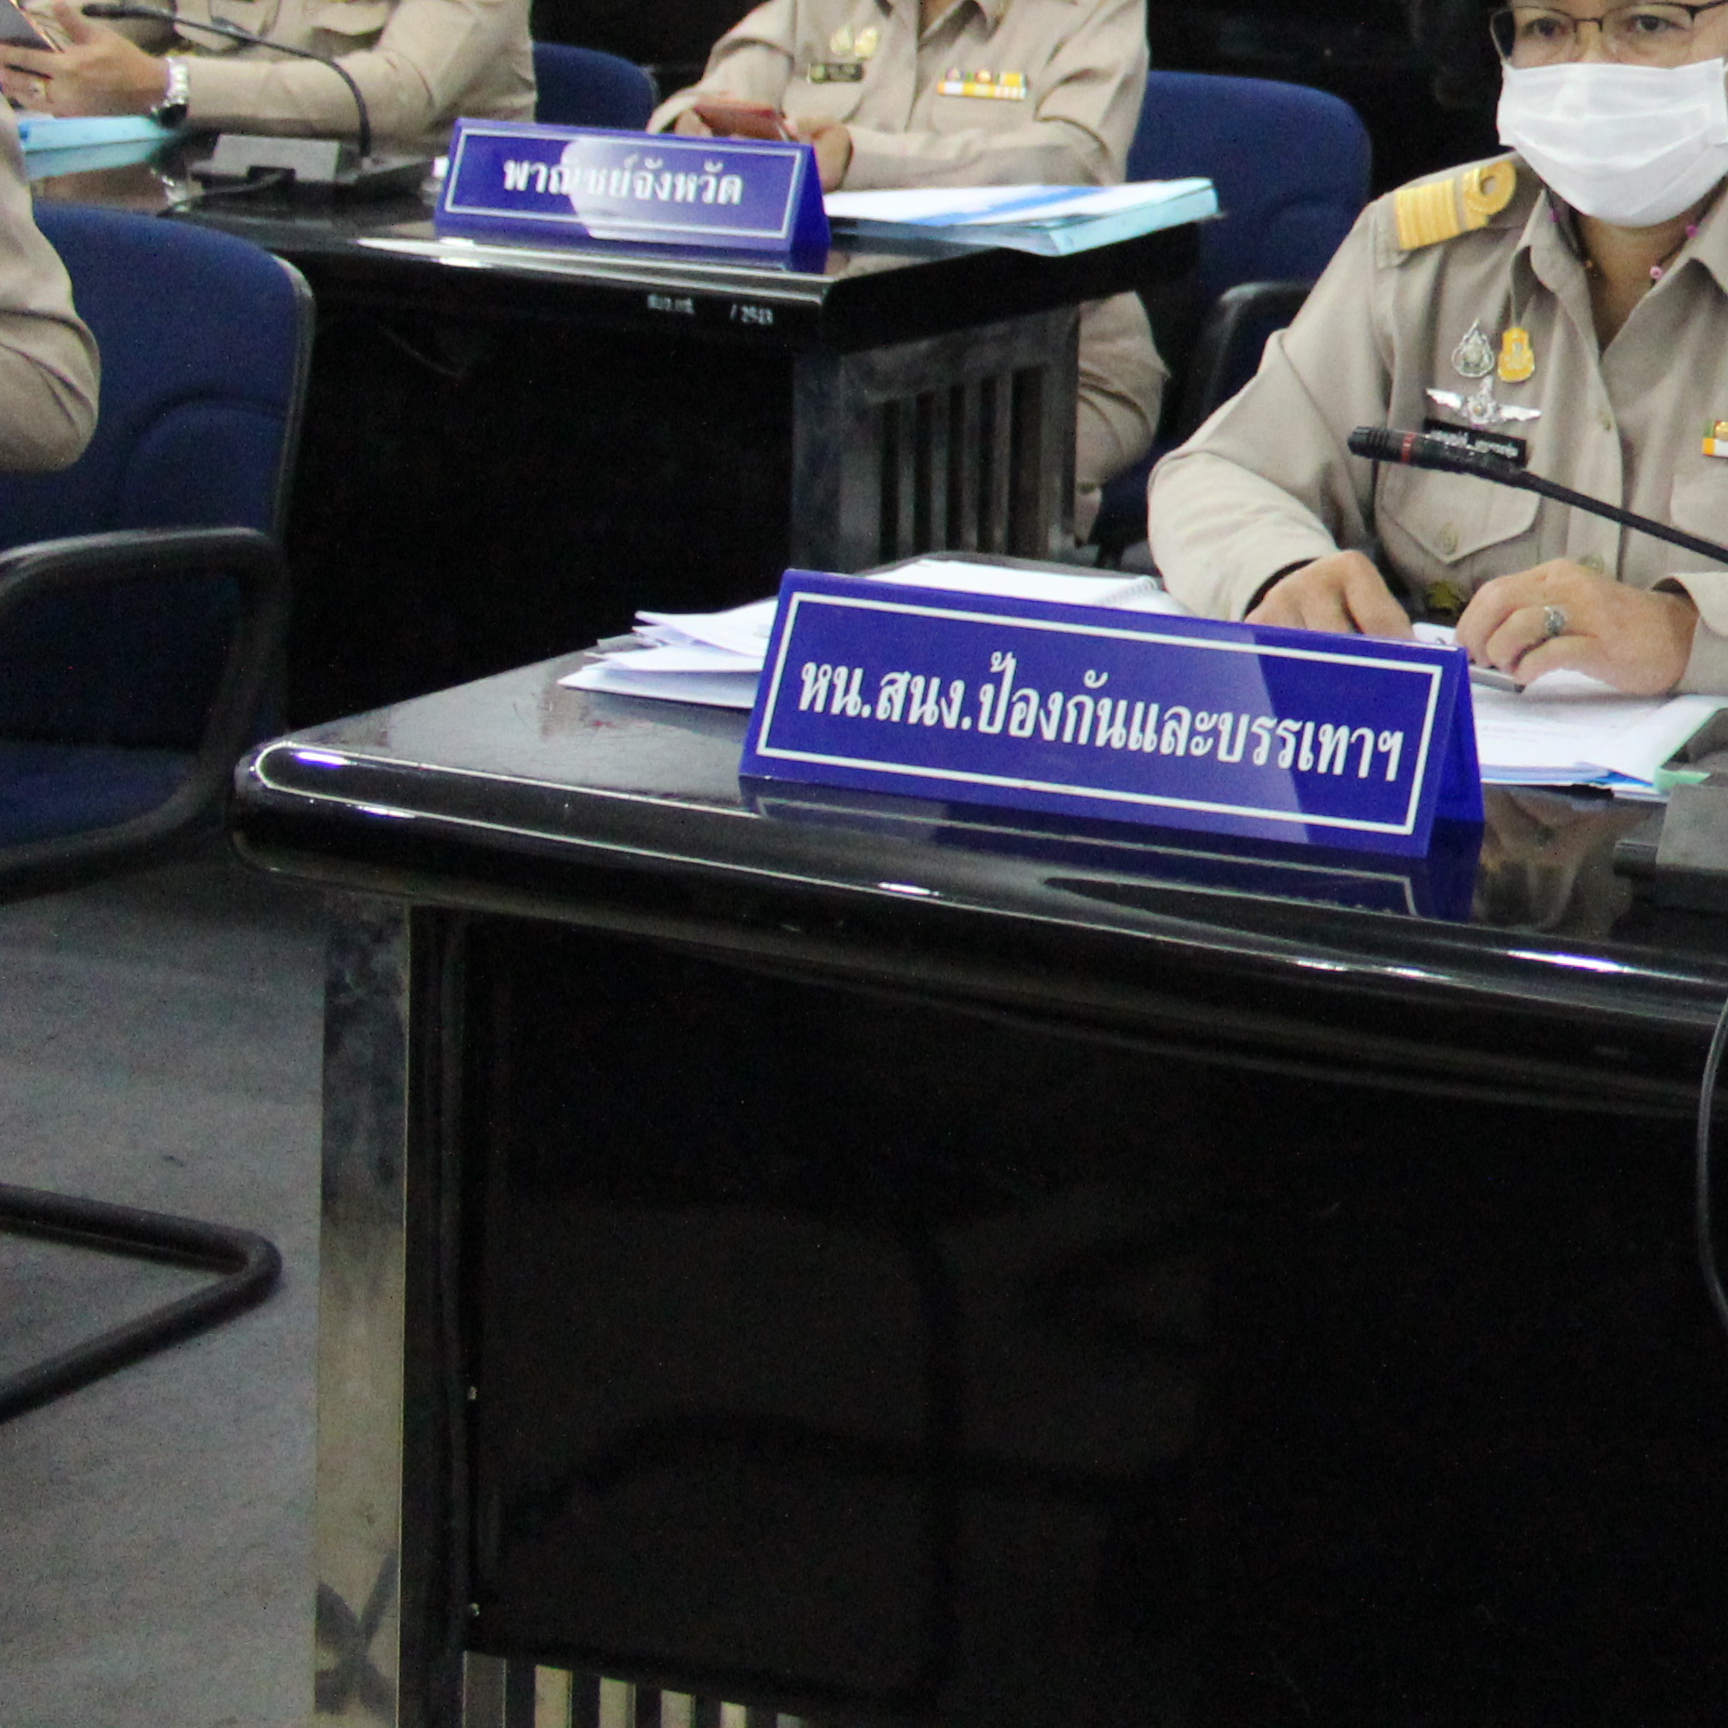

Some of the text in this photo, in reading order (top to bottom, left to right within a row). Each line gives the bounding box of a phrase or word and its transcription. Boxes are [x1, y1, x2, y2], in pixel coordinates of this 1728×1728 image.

[503, 153, 744, 206] พาณิชย์จังหวัด
[797, 649, 1404, 783] หน.สนง.ป้องกันและบรรเทาฯ
